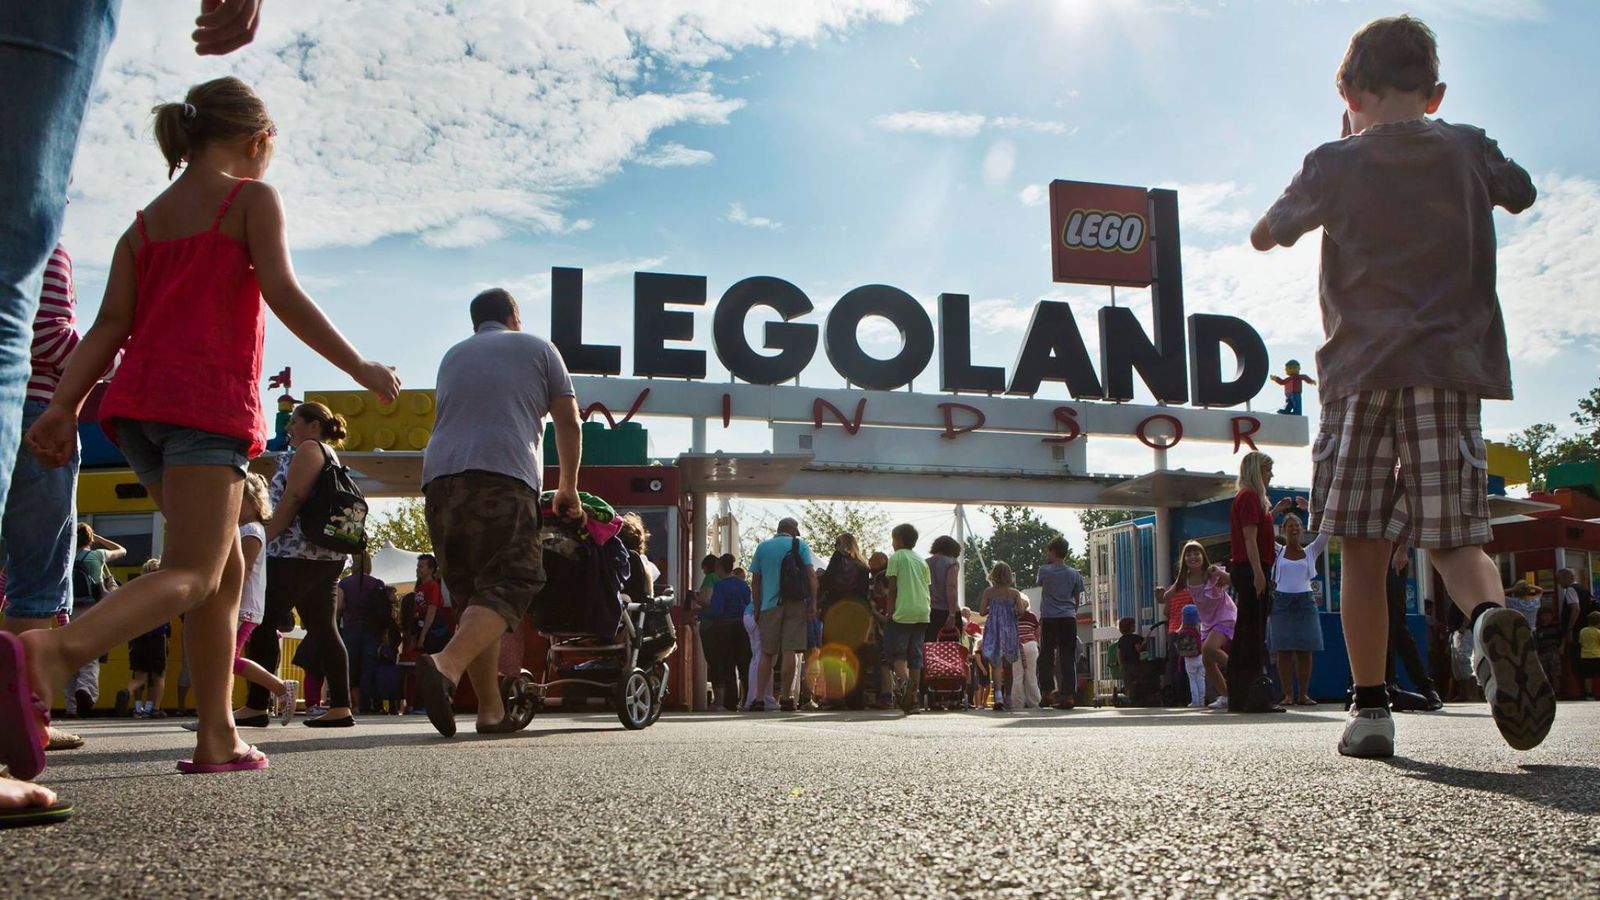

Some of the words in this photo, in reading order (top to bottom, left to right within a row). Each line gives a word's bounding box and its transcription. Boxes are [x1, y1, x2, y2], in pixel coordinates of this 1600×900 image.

[1064, 211, 1144, 251] LEGO
[551, 188, 1270, 408] LEGOLAND
[580, 387, 1261, 455] WINDSOR
